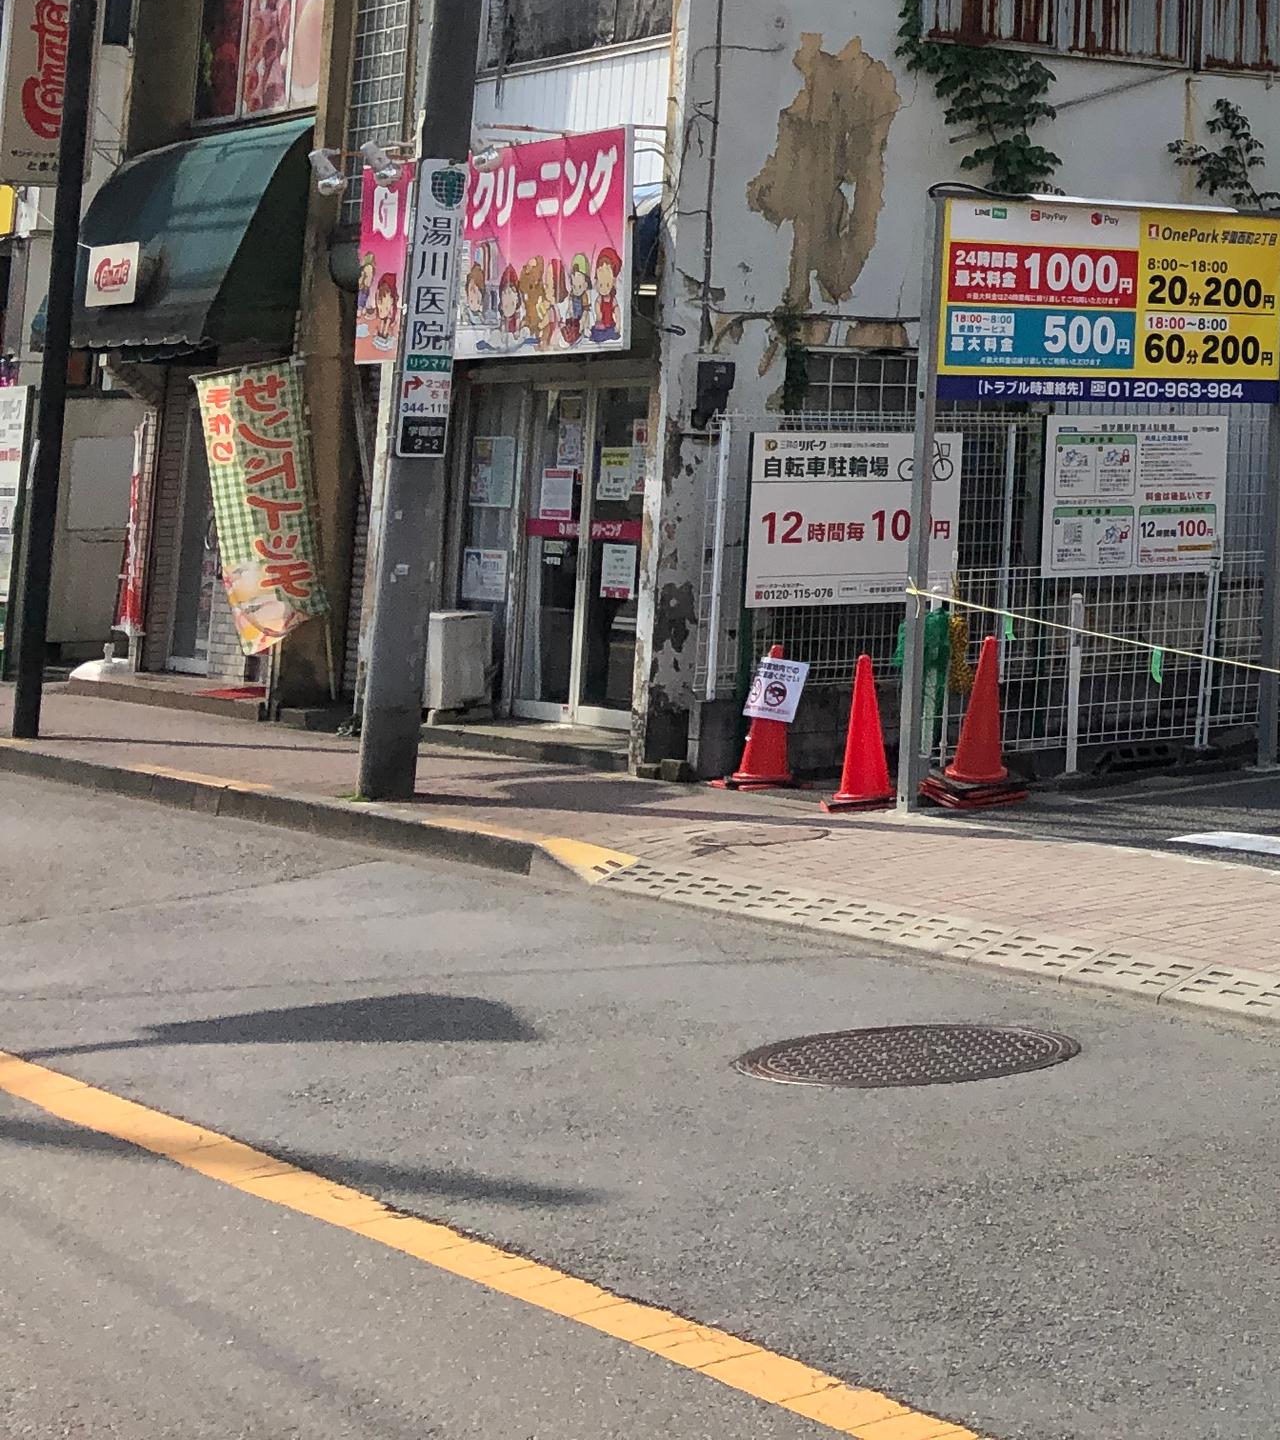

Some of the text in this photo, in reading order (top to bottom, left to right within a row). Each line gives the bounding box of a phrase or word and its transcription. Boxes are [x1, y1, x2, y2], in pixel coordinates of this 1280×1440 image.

[974, 208, 990, 217] LINE
[1041, 212, 1068, 222] PayPay
[1104, 215, 1119, 226] Pay
[1162, 226, 1219, 243] OnePark
[955, 250, 1018, 269] 24時間毎
[954, 269, 1017, 289] 最大料金
[1024, 252, 1133, 294] 1000円
[411, 215, 452, 351] 湯川医院
[1147, 275, 1275, 309] 20分200円
[1043, 315, 1131, 355] 500円
[951, 337, 1014, 353] 最大料金
[1144, 333, 1273, 366] 60分200円
[1108, 381, 1244, 399] 0120-963-984
[414, 439, 439, 450] 2-2
[764, 456, 889, 479] 自転車駐輪場
[764, 588, 834, 601] 0120-115-076
